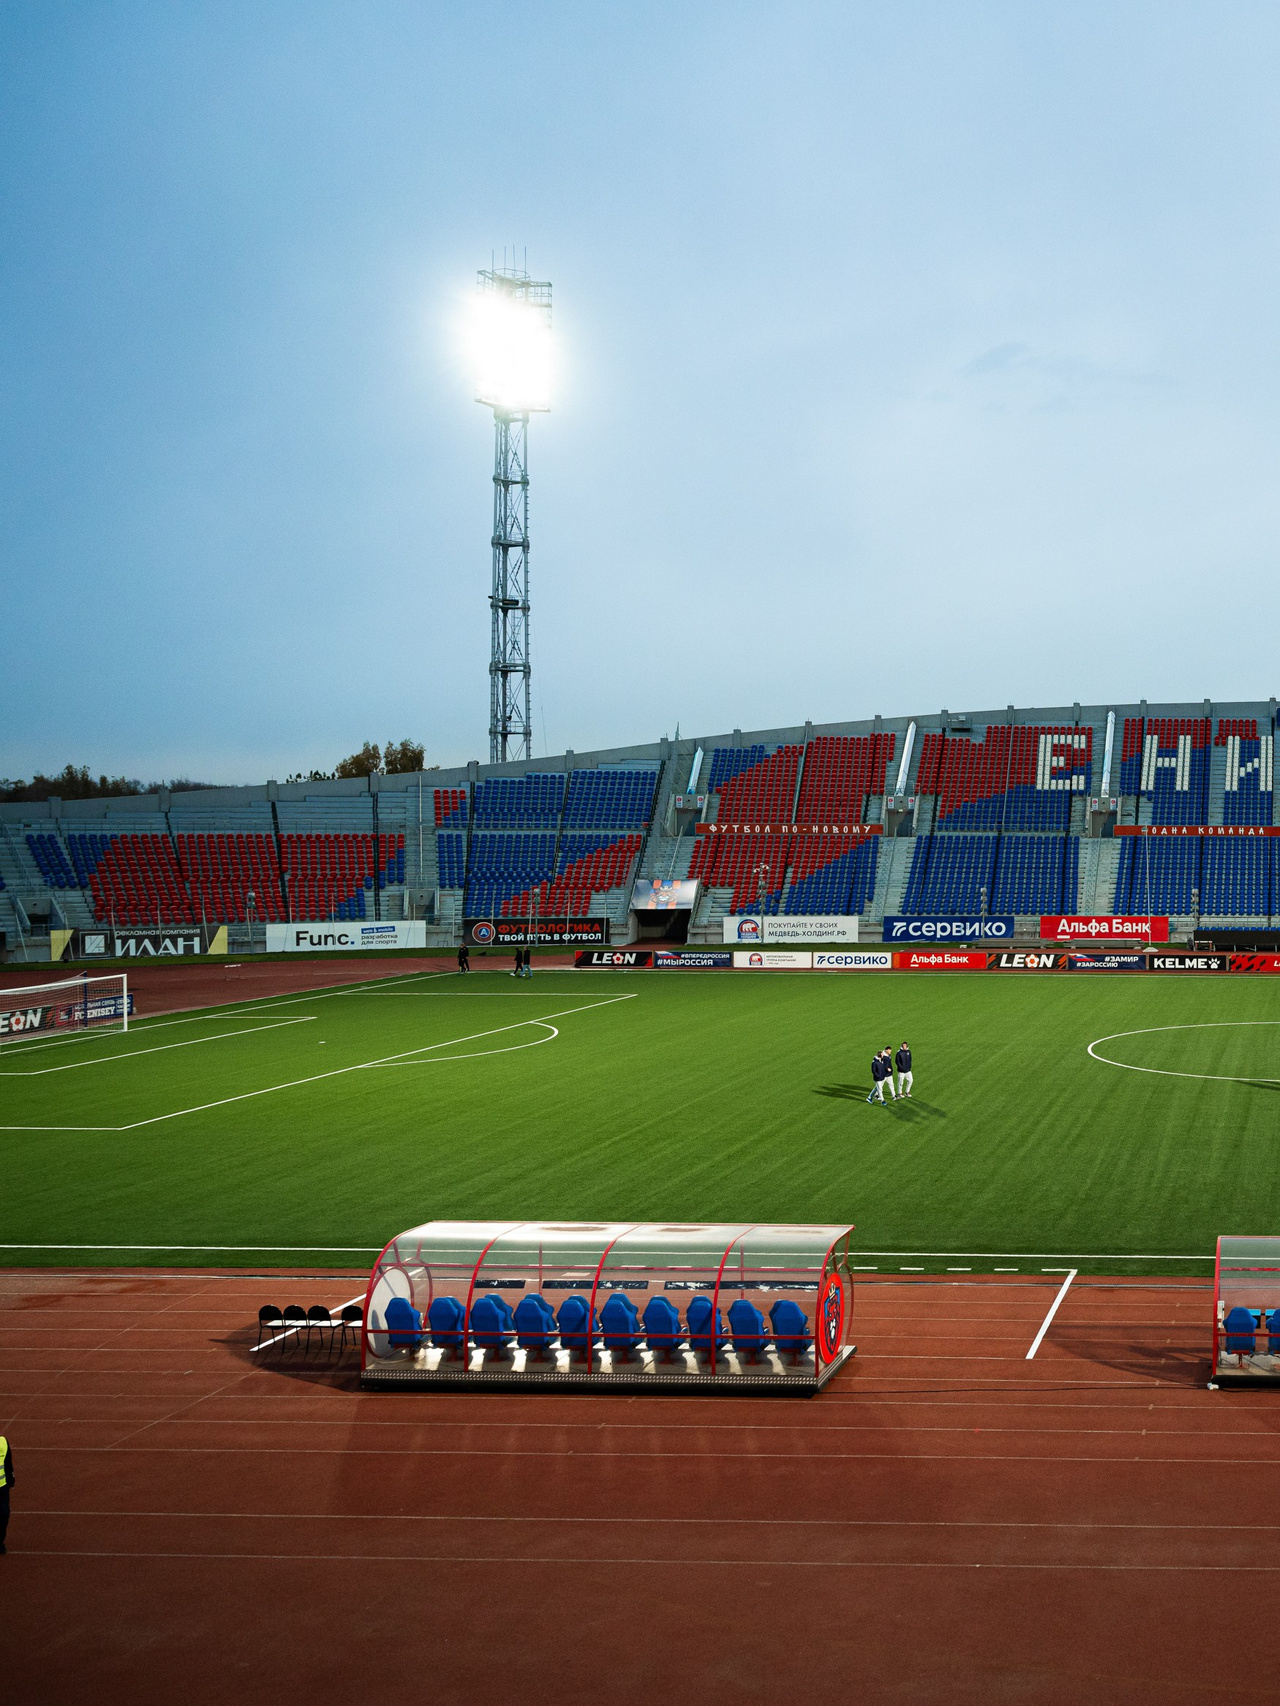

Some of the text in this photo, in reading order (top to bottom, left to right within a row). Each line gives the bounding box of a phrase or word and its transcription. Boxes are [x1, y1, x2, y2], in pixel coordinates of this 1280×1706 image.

[709, 824, 871, 833] ФУТБОЛ ПО-НОВОМУ
[1152, 827, 1264, 835] ОДНА КОМАНДА
[115, 929, 160, 937] рекламная
[498, 923, 601, 934] ФУТБОЛОГИКА
[908, 921, 1006, 938] сервико
[1057, 919, 1151, 936] Альфа Банк
[295, 931, 355, 946] Func.
[498, 933, 524, 942] ТВОЙ
[115, 937, 200, 957] ИЛАН
[592, 952, 636, 965] LEON
[827, 954, 888, 966] сервико
[910, 954, 969, 964] Альфа Банк
[1000, 954, 1054, 968] LEON
[1153, 957, 1208, 969] KELME
[0, 1008, 42, 1033] EON
